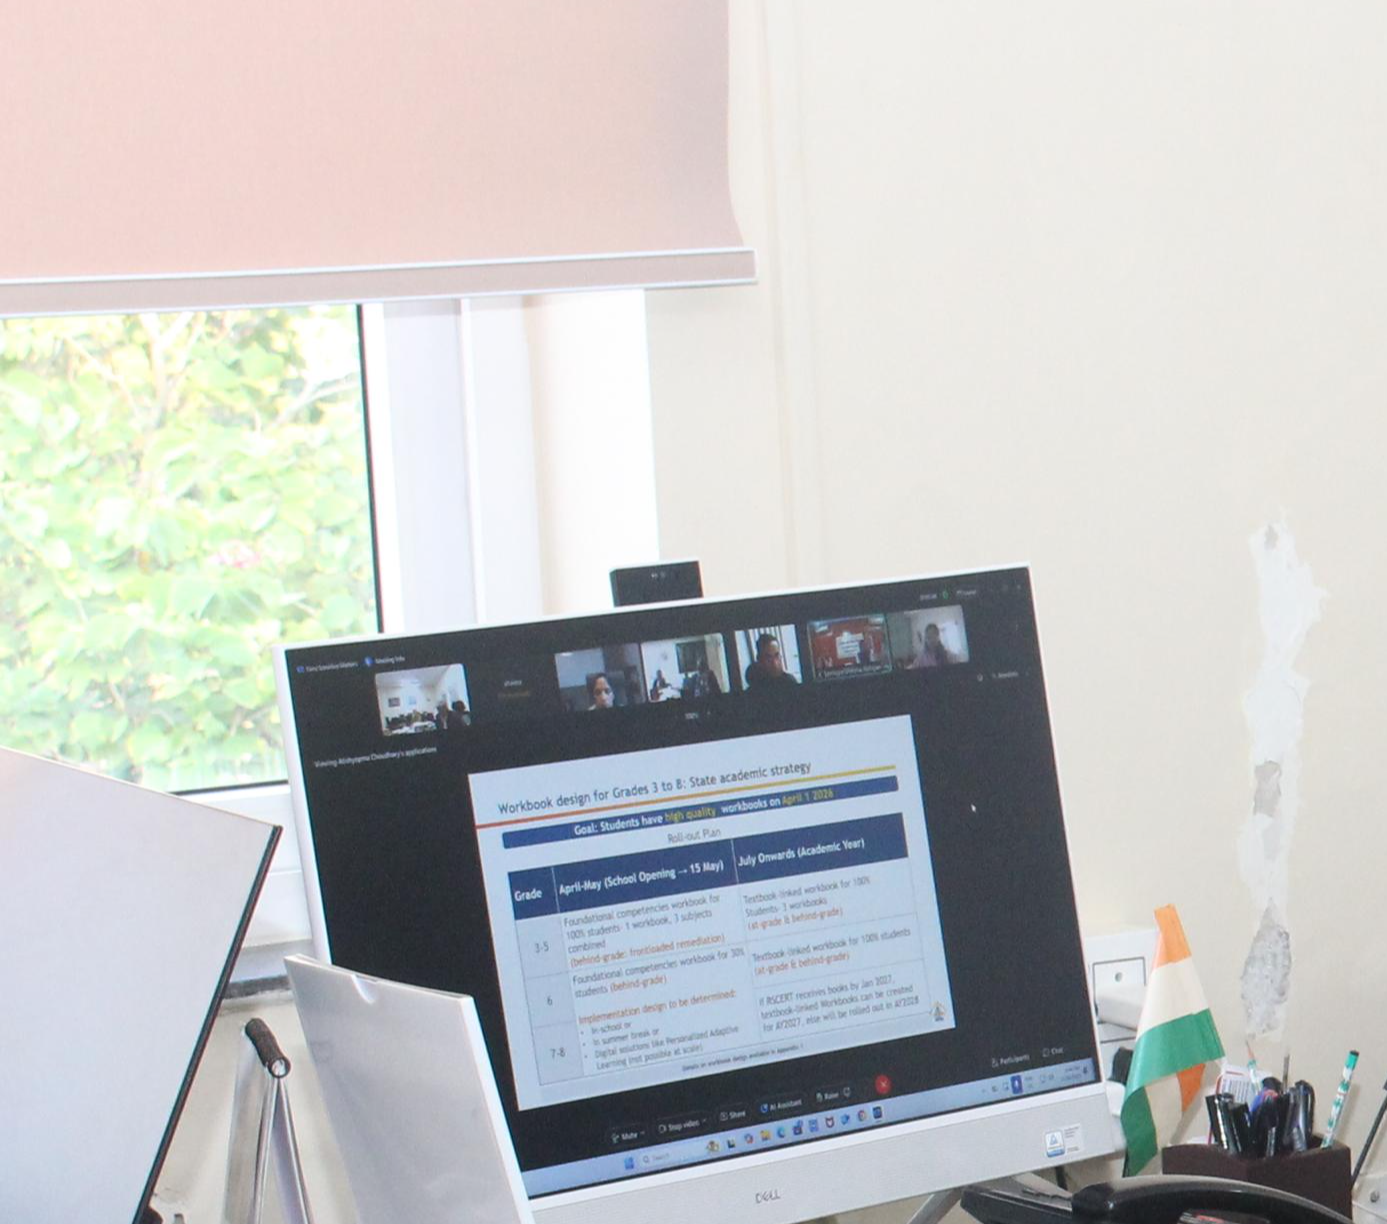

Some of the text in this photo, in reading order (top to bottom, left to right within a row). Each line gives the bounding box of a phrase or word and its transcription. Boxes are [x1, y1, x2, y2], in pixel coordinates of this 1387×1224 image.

[498, 761, 811, 815] Workbook design for Grades 3 to 8: State academic strategy
[573, 822, 597, 835] Goal:
[600, 816, 638, 831] Students
[641, 813, 662, 825] have
[664, 810, 684, 824] high
[686, 805, 715, 821] quality
[721, 798, 767, 814] workbooks
[769, 798, 780, 807] on
[782, 793, 803, 807] April
[667, 826, 720, 843] Roll-out Plan
[737, 837, 864, 869] July Onwards (Academic Year)
[558, 859, 724, 896] April-May (School Opening 15 May)
[514, 887, 542, 901] Grade
[803, 881, 838, 894] workbook
[840, 879, 850, 888] for
[564, 894, 719, 927] Foundational competencies workbook for
[681, 909, 711, 922] subjects
[534, 942, 549, 953] 3-5
[568, 940, 605, 953] combined
[812, 938, 846, 951] workbook
[849, 936, 858, 945] for
[572, 950, 728, 984] Foundational competencies workbook for
[574, 984, 608, 998] students
